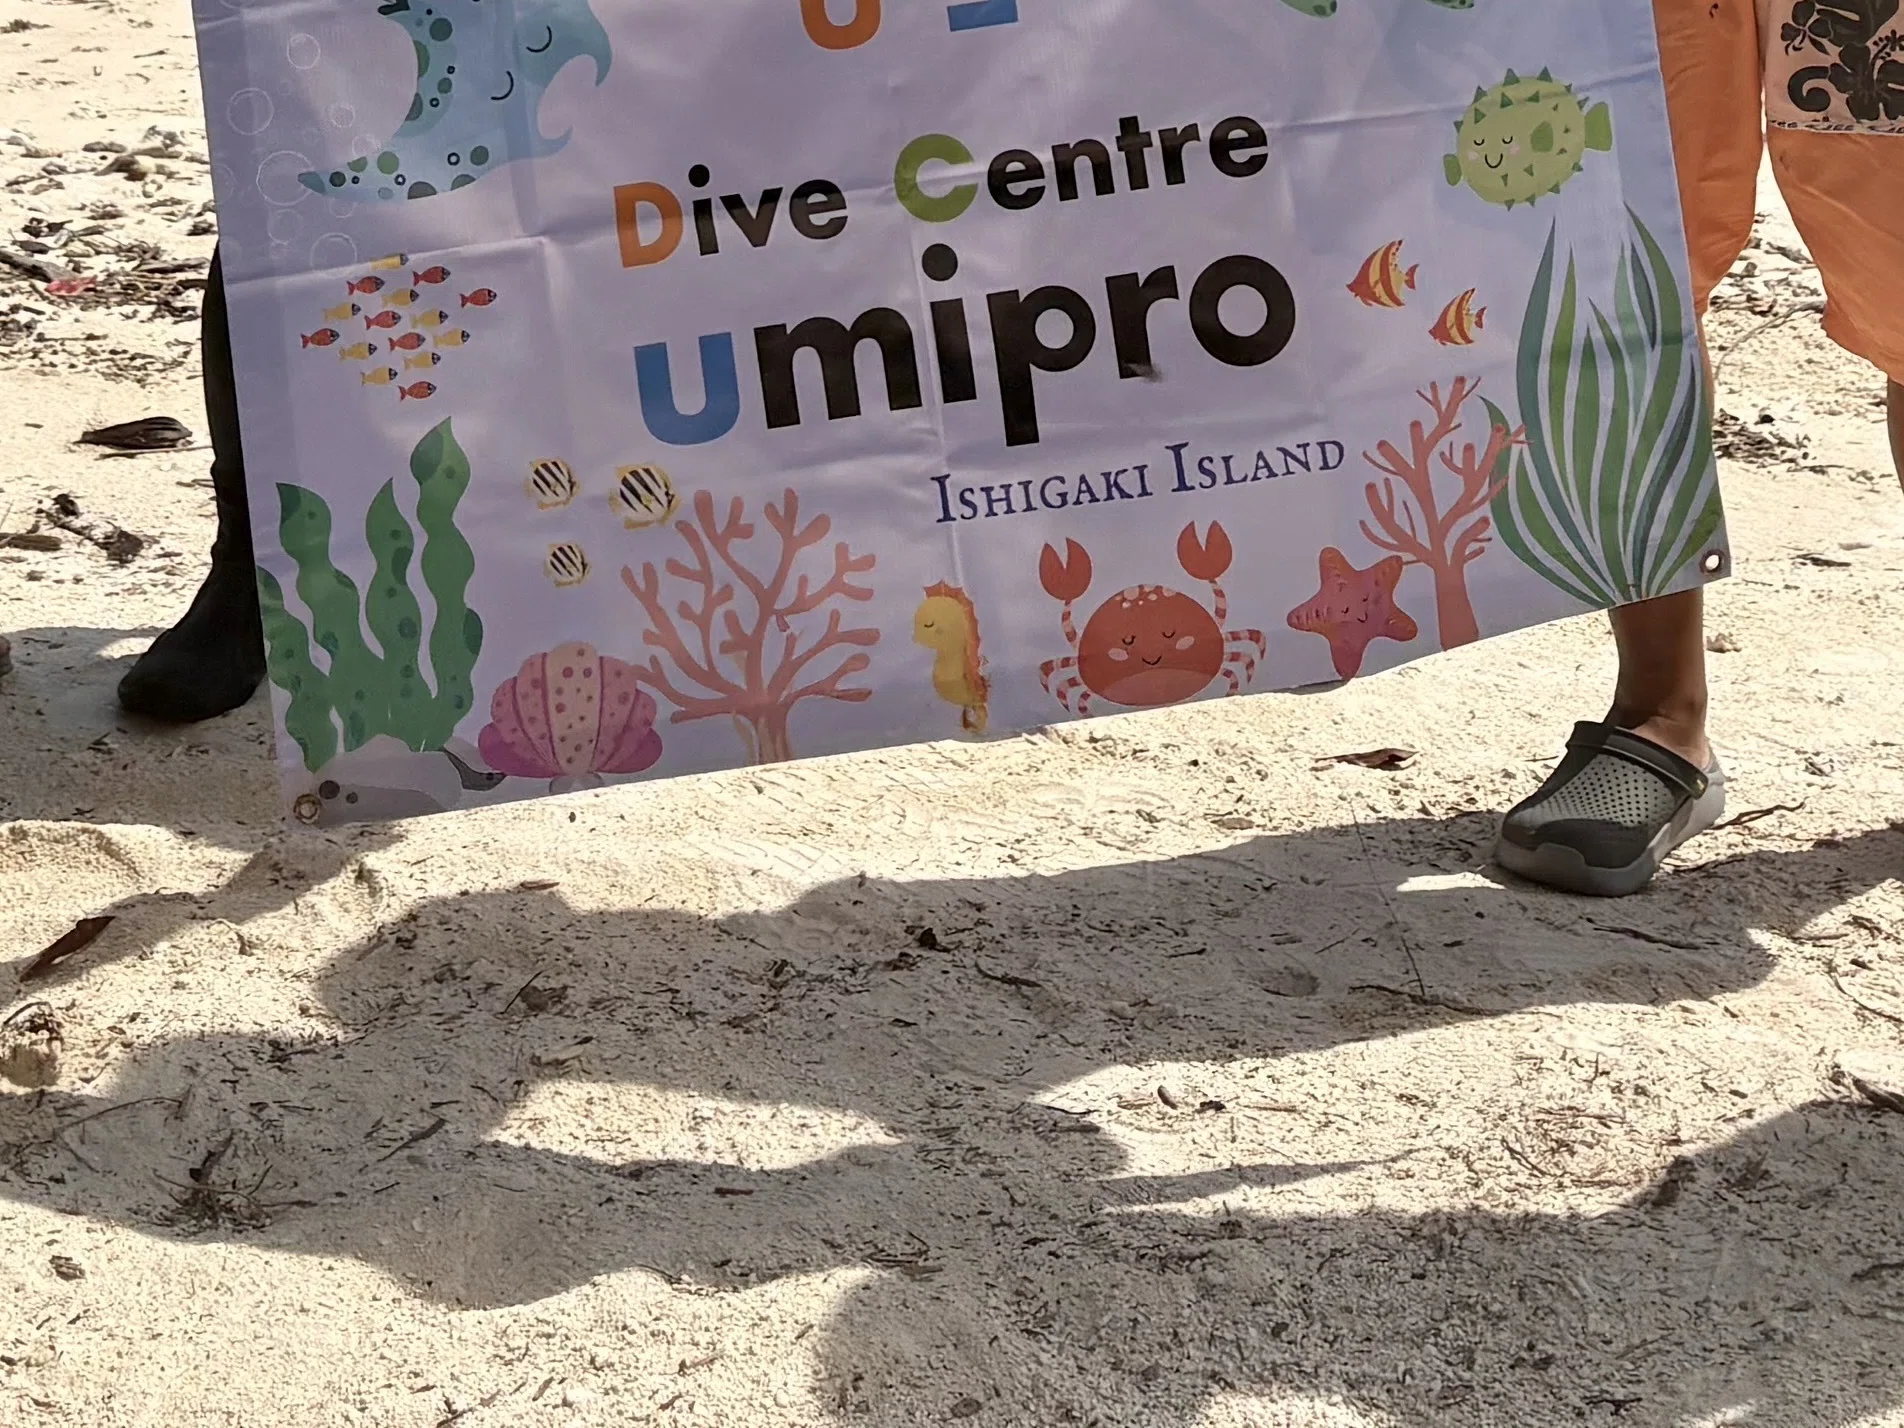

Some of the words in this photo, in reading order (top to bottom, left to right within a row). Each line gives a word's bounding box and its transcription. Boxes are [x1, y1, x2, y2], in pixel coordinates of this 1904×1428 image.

[613, 163, 848, 268] Dive
[893, 115, 1269, 223] Centre
[930, 463, 1151, 524] ISHIGAKI
[1165, 439, 1345, 494] ISLAND
